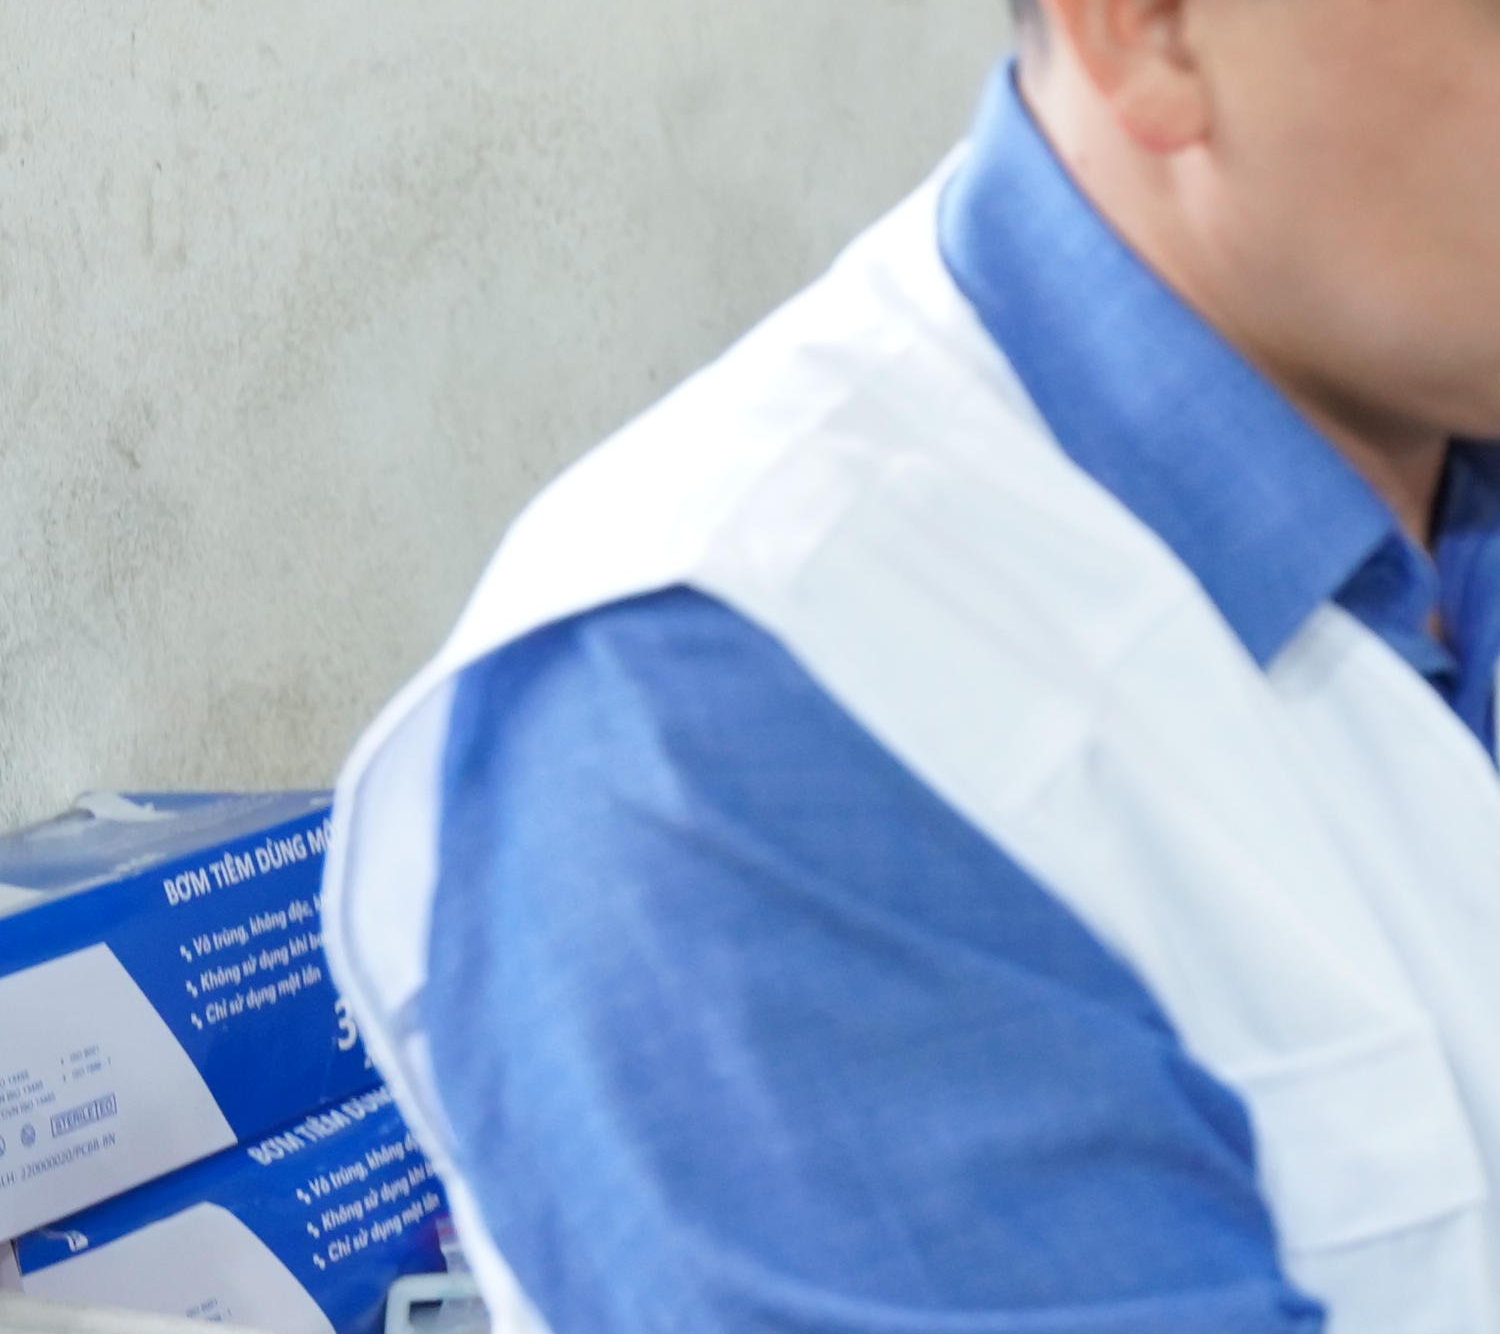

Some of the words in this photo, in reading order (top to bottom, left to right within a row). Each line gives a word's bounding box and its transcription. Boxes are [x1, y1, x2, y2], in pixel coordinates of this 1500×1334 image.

[163, 868, 211, 906] BƠM
[209, 851, 255, 889] TIÊM
[255, 836, 307, 874] DÙNG
[192, 933, 212, 956] Vô
[249, 908, 287, 937] không
[200, 961, 241, 993] Không
